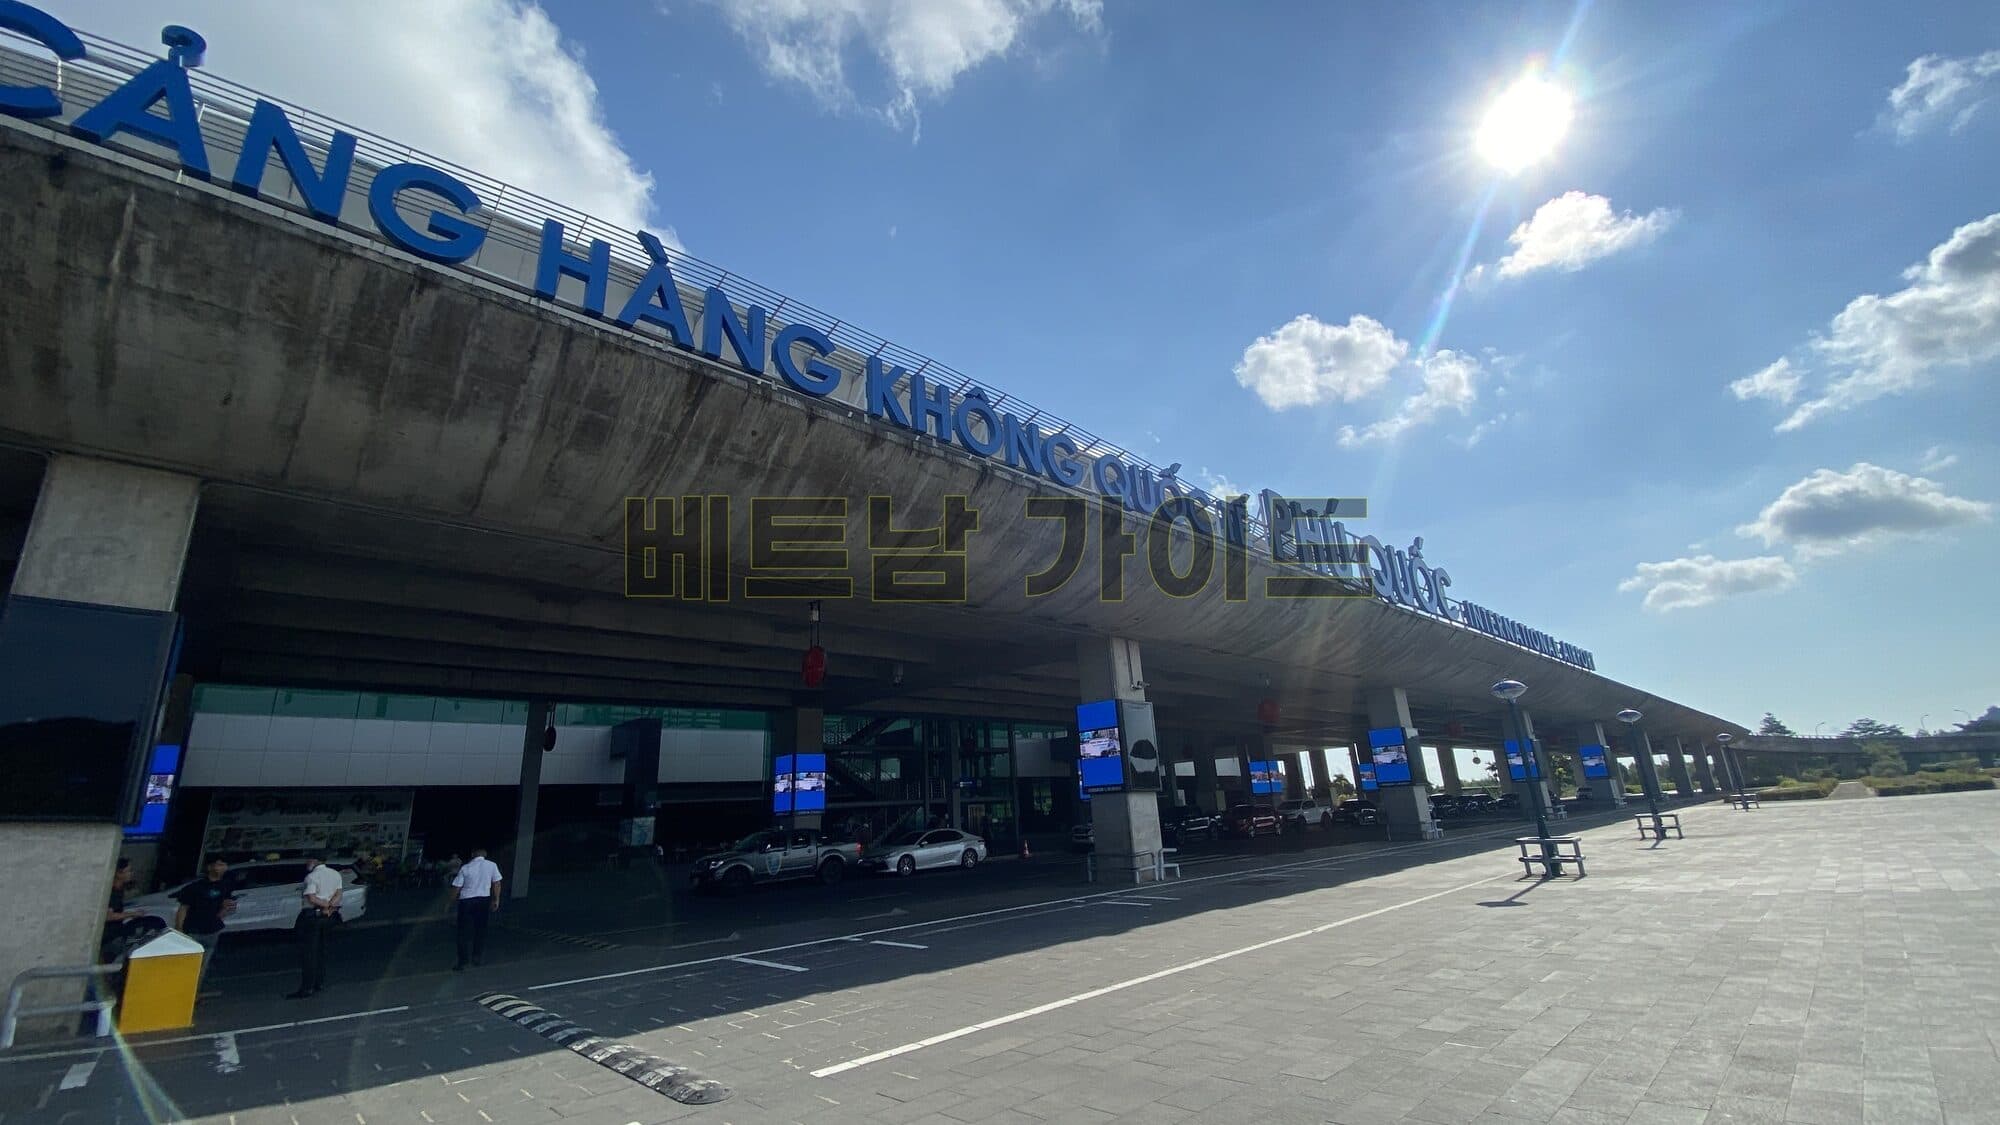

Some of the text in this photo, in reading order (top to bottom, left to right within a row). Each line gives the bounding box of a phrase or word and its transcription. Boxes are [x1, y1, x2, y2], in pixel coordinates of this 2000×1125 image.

[534, 218, 842, 397] HÀNG
[865, 354, 1083, 487] KHÔNG
[1094, 454, 1213, 535] QUỐC
[1261, 488, 1354, 578] PHÚ
[1359, 534, 1460, 621] QUỐC
